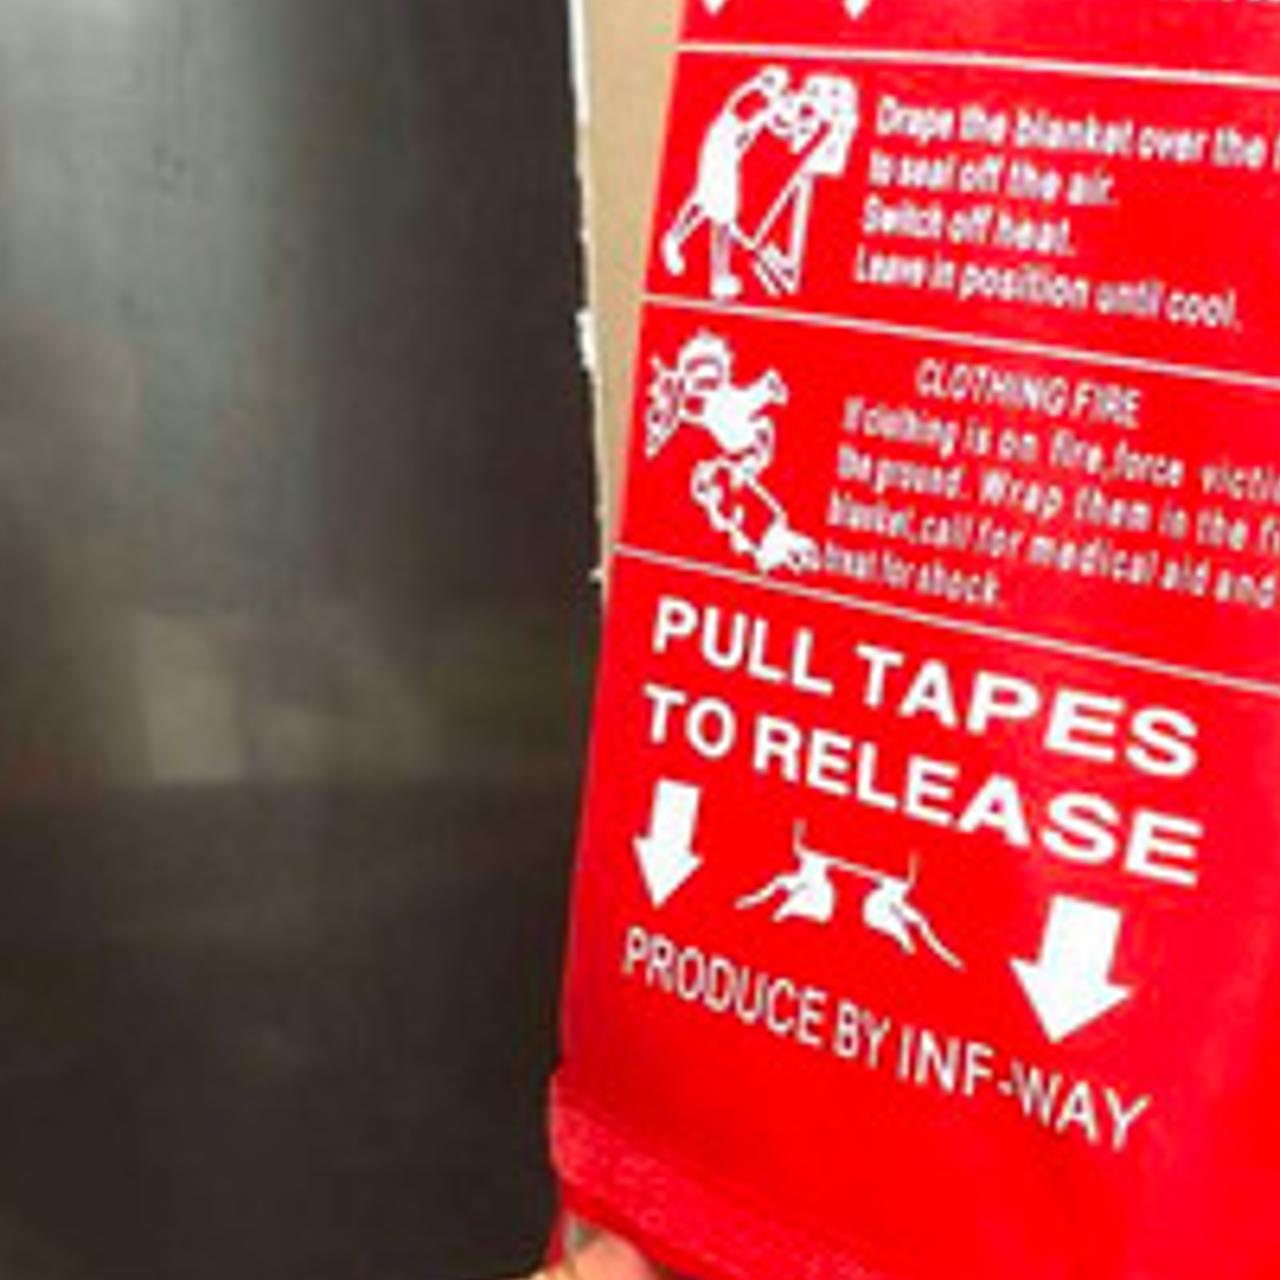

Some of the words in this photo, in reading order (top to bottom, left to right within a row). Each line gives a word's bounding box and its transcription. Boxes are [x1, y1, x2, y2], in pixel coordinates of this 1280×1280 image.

[958, 101, 1007, 147] the
[1013, 102, 1134, 158] blanket
[1137, 123, 1210, 162] over
[1212, 125, 1267, 170] the
[862, 192, 943, 240] Switch
[946, 202, 995, 244] off
[898, 153, 956, 192] seal
[957, 153, 1005, 193] off
[1006, 158, 1062, 205] the
[854, 242, 927, 289] Leave
[928, 250, 956, 292] in
[957, 262, 1089, 311] position
[1094, 278, 1164, 320] until
[916, 358, 1066, 418] CLOTHING
[1070, 378, 1142, 430] FIRE
[965, 414, 993, 457] is
[997, 426, 1039, 464] on
[979, 469, 1065, 521] Wrap
[1073, 485, 1153, 533] them
[1158, 496, 1189, 542] in
[1195, 505, 1250, 553] the
[972, 516, 1024, 561] for
[1028, 534, 1161, 587] medical
[1160, 552, 1212, 598] aid
[1213, 570, 1279, 611] and
[652, 595, 834, 697] PULL
[855, 642, 1200, 778] TAPES
[643, 683, 737, 760] TO
[752, 714, 1206, 889] RELEASE
[622, 925, 829, 1048] PRODUCE
[833, 998, 892, 1069] BY
[894, 1027, 1152, 1154] INF-WAY
